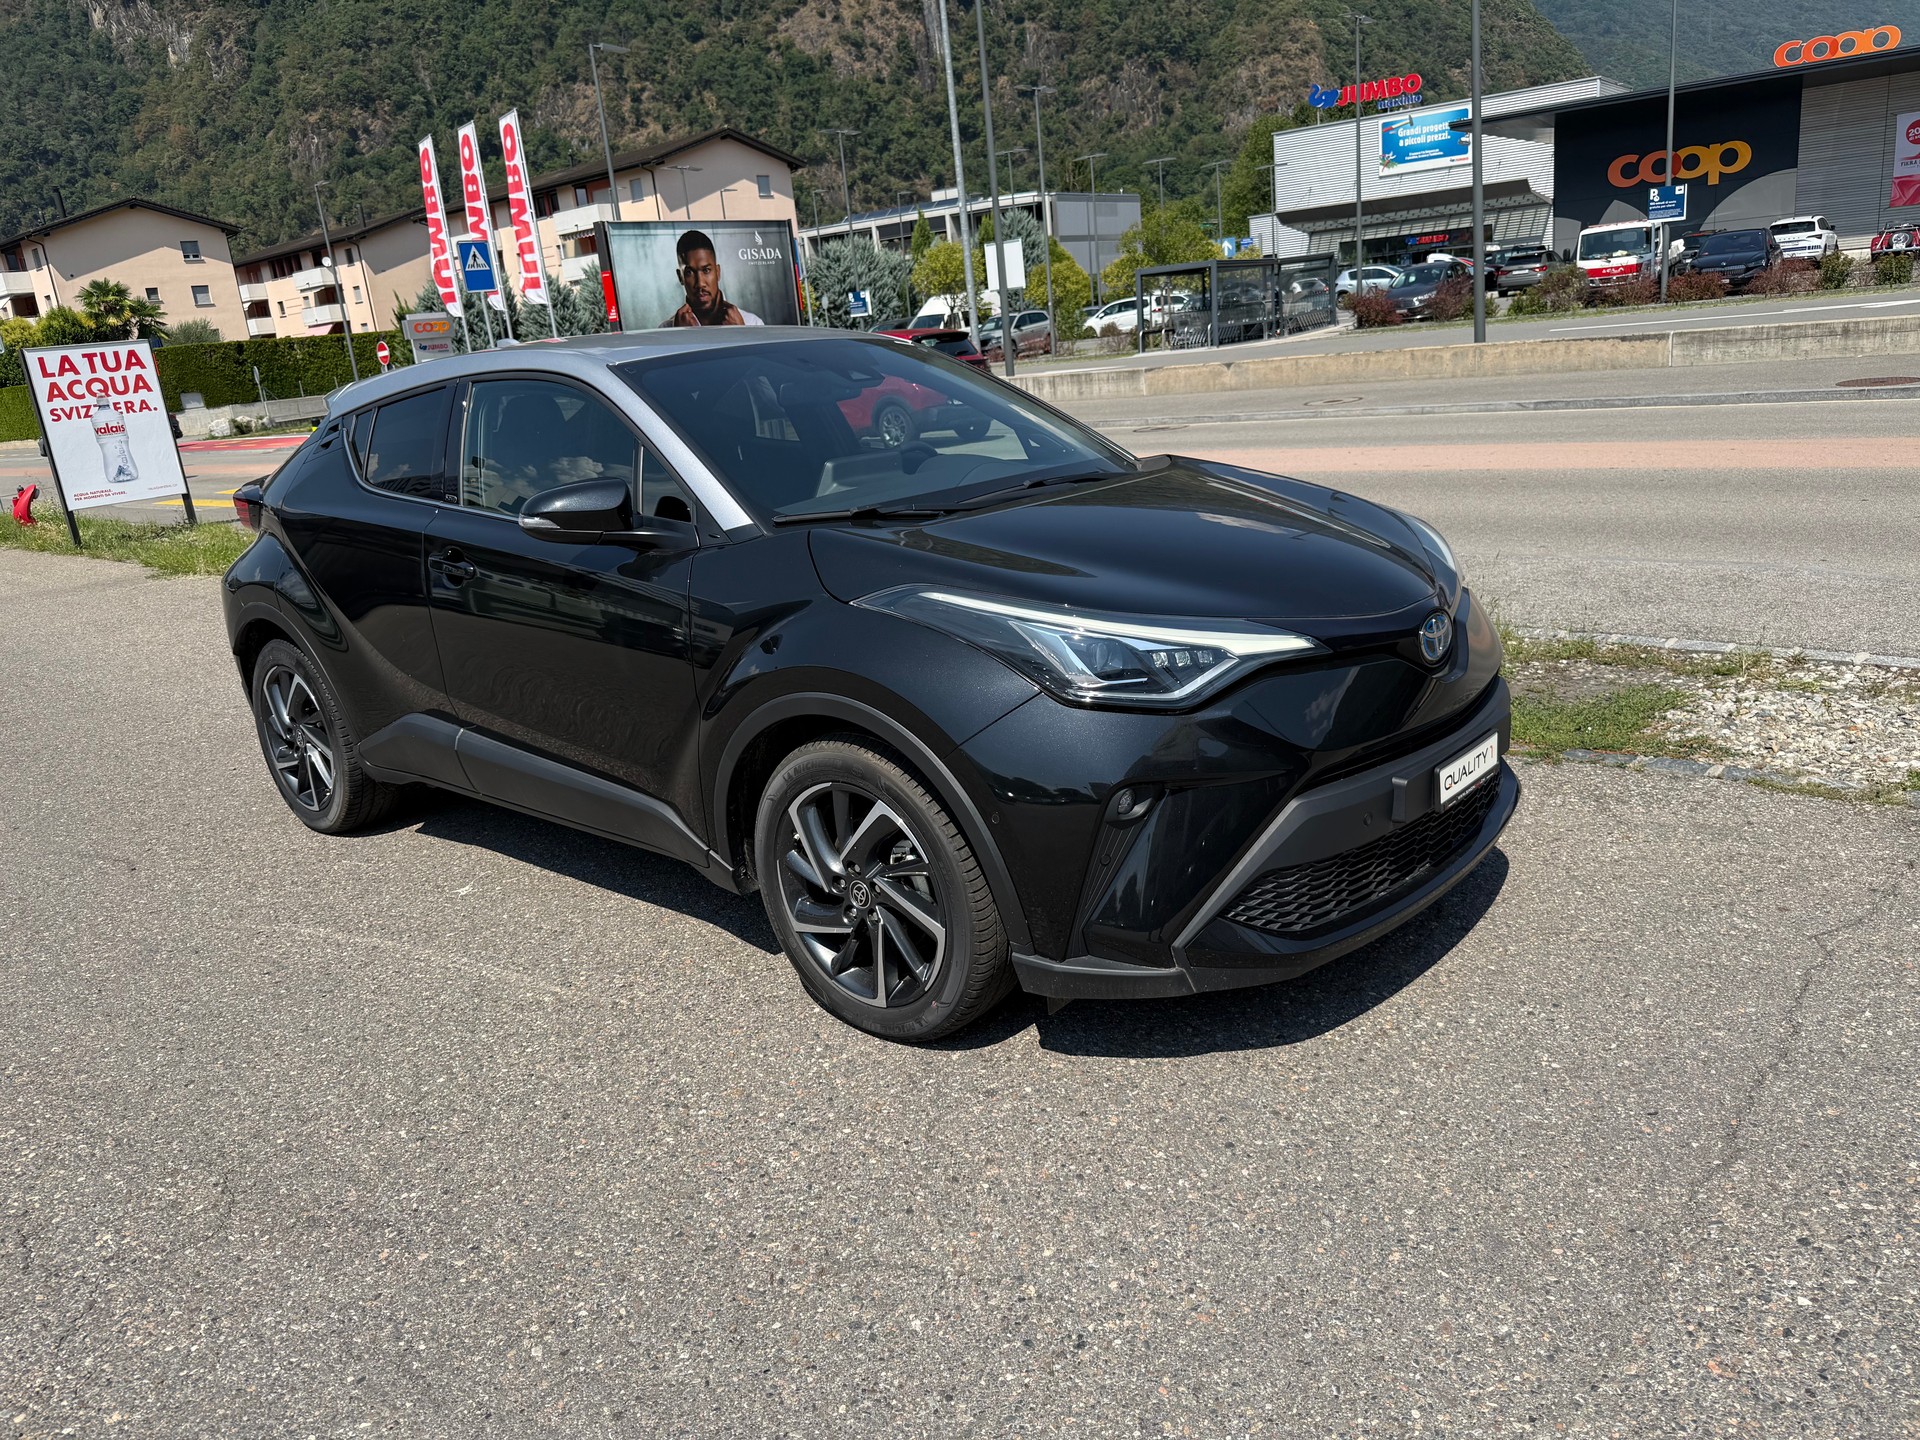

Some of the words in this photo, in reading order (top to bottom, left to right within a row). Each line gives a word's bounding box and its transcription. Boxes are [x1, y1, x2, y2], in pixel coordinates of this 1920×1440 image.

[1773, 25, 1902, 68] coop
[1337, 73, 1423, 107] JUMBO
[1397, 125, 1421, 137] Grandi
[1422, 121, 1451, 134] progett
[1398, 139, 1404, 147] a
[1404, 135, 1426, 146] piccoli
[1426, 131, 1451, 143] prezzi.
[1607, 140, 1752, 188] coop
[738, 247, 782, 260] GISADA
[413, 321, 450, 334] coop
[37, 355, 81, 378] LA
[81, 349, 147, 374] TUA
[46, 374, 153, 403] ACQUA
[49, 399, 158, 422] SVIZERA.
[94, 422, 126, 435] valais
[1444, 747, 1489, 790] QUALITY
